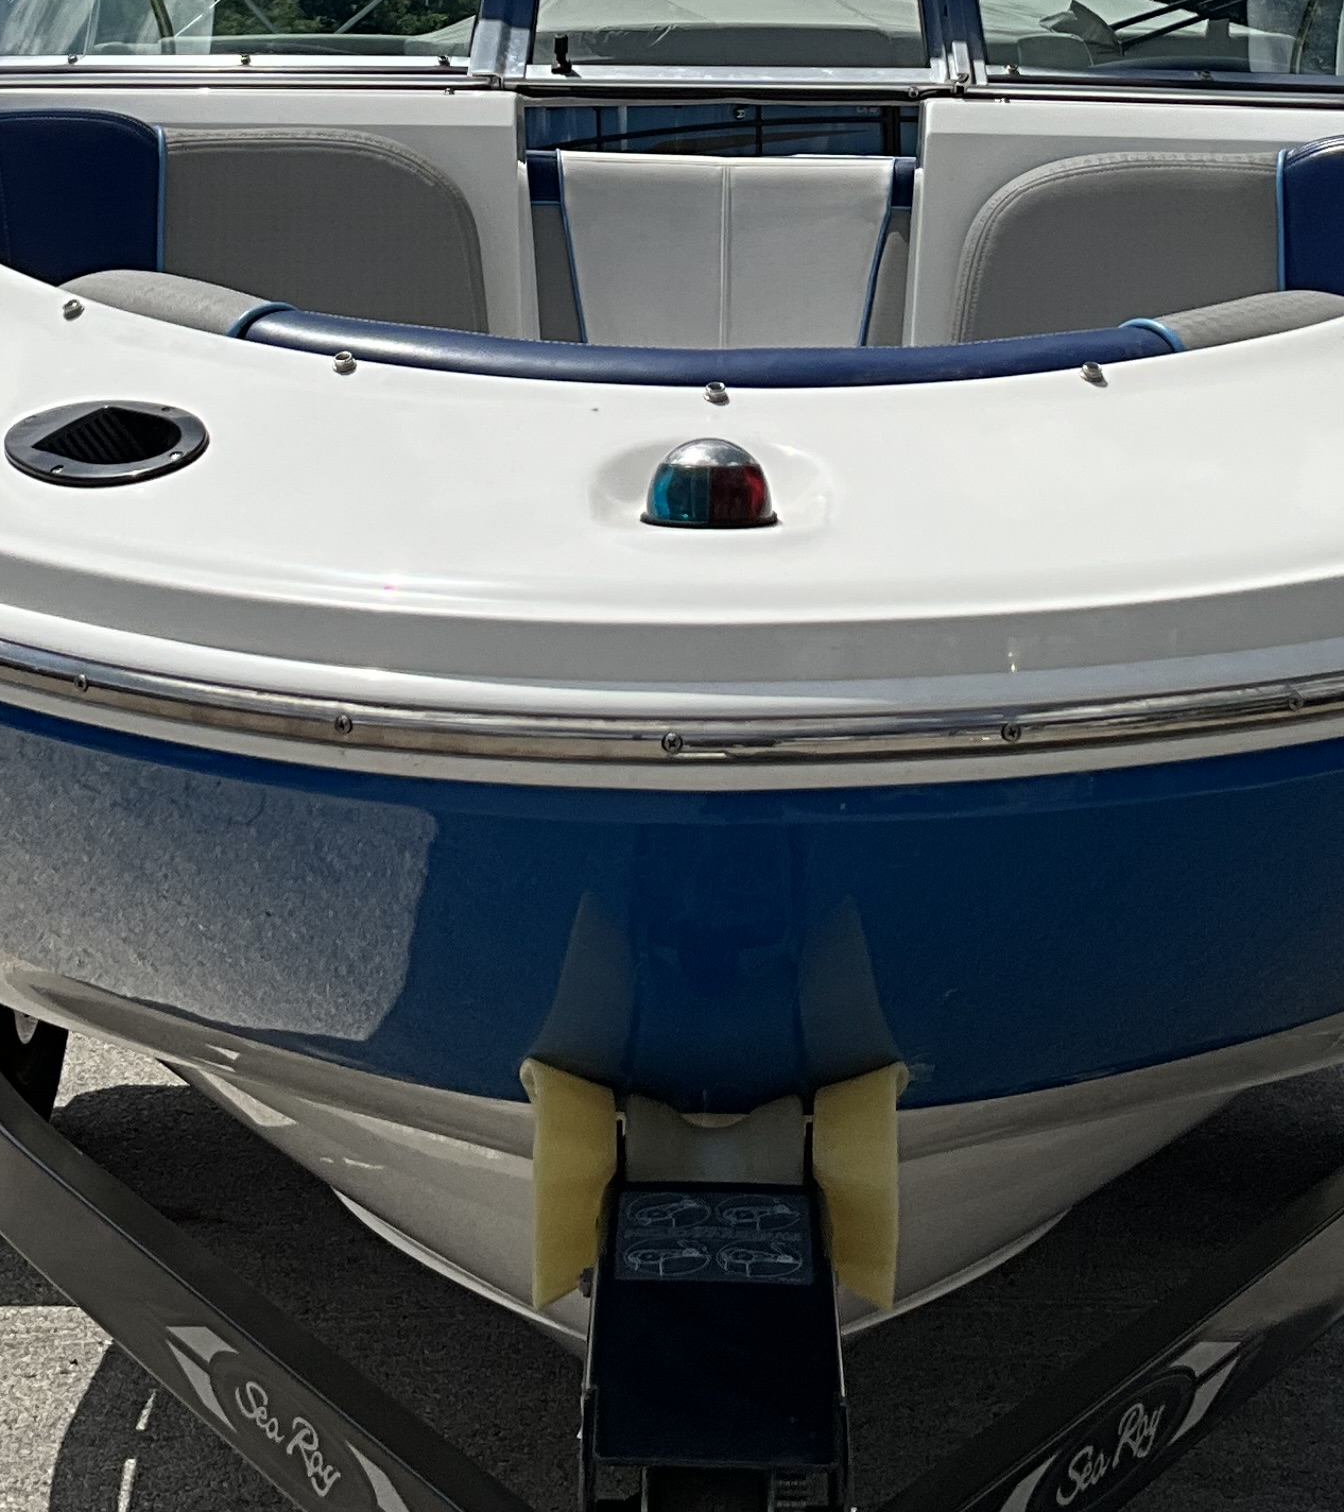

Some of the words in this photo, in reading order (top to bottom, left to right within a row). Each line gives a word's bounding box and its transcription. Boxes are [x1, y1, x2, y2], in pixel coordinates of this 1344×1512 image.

[235, 1381, 285, 1443] Sea
[286, 1416, 341, 1497] Ray
[1056, 1445, 1110, 1506] Sea
[1112, 1402, 1166, 1470] Ray
